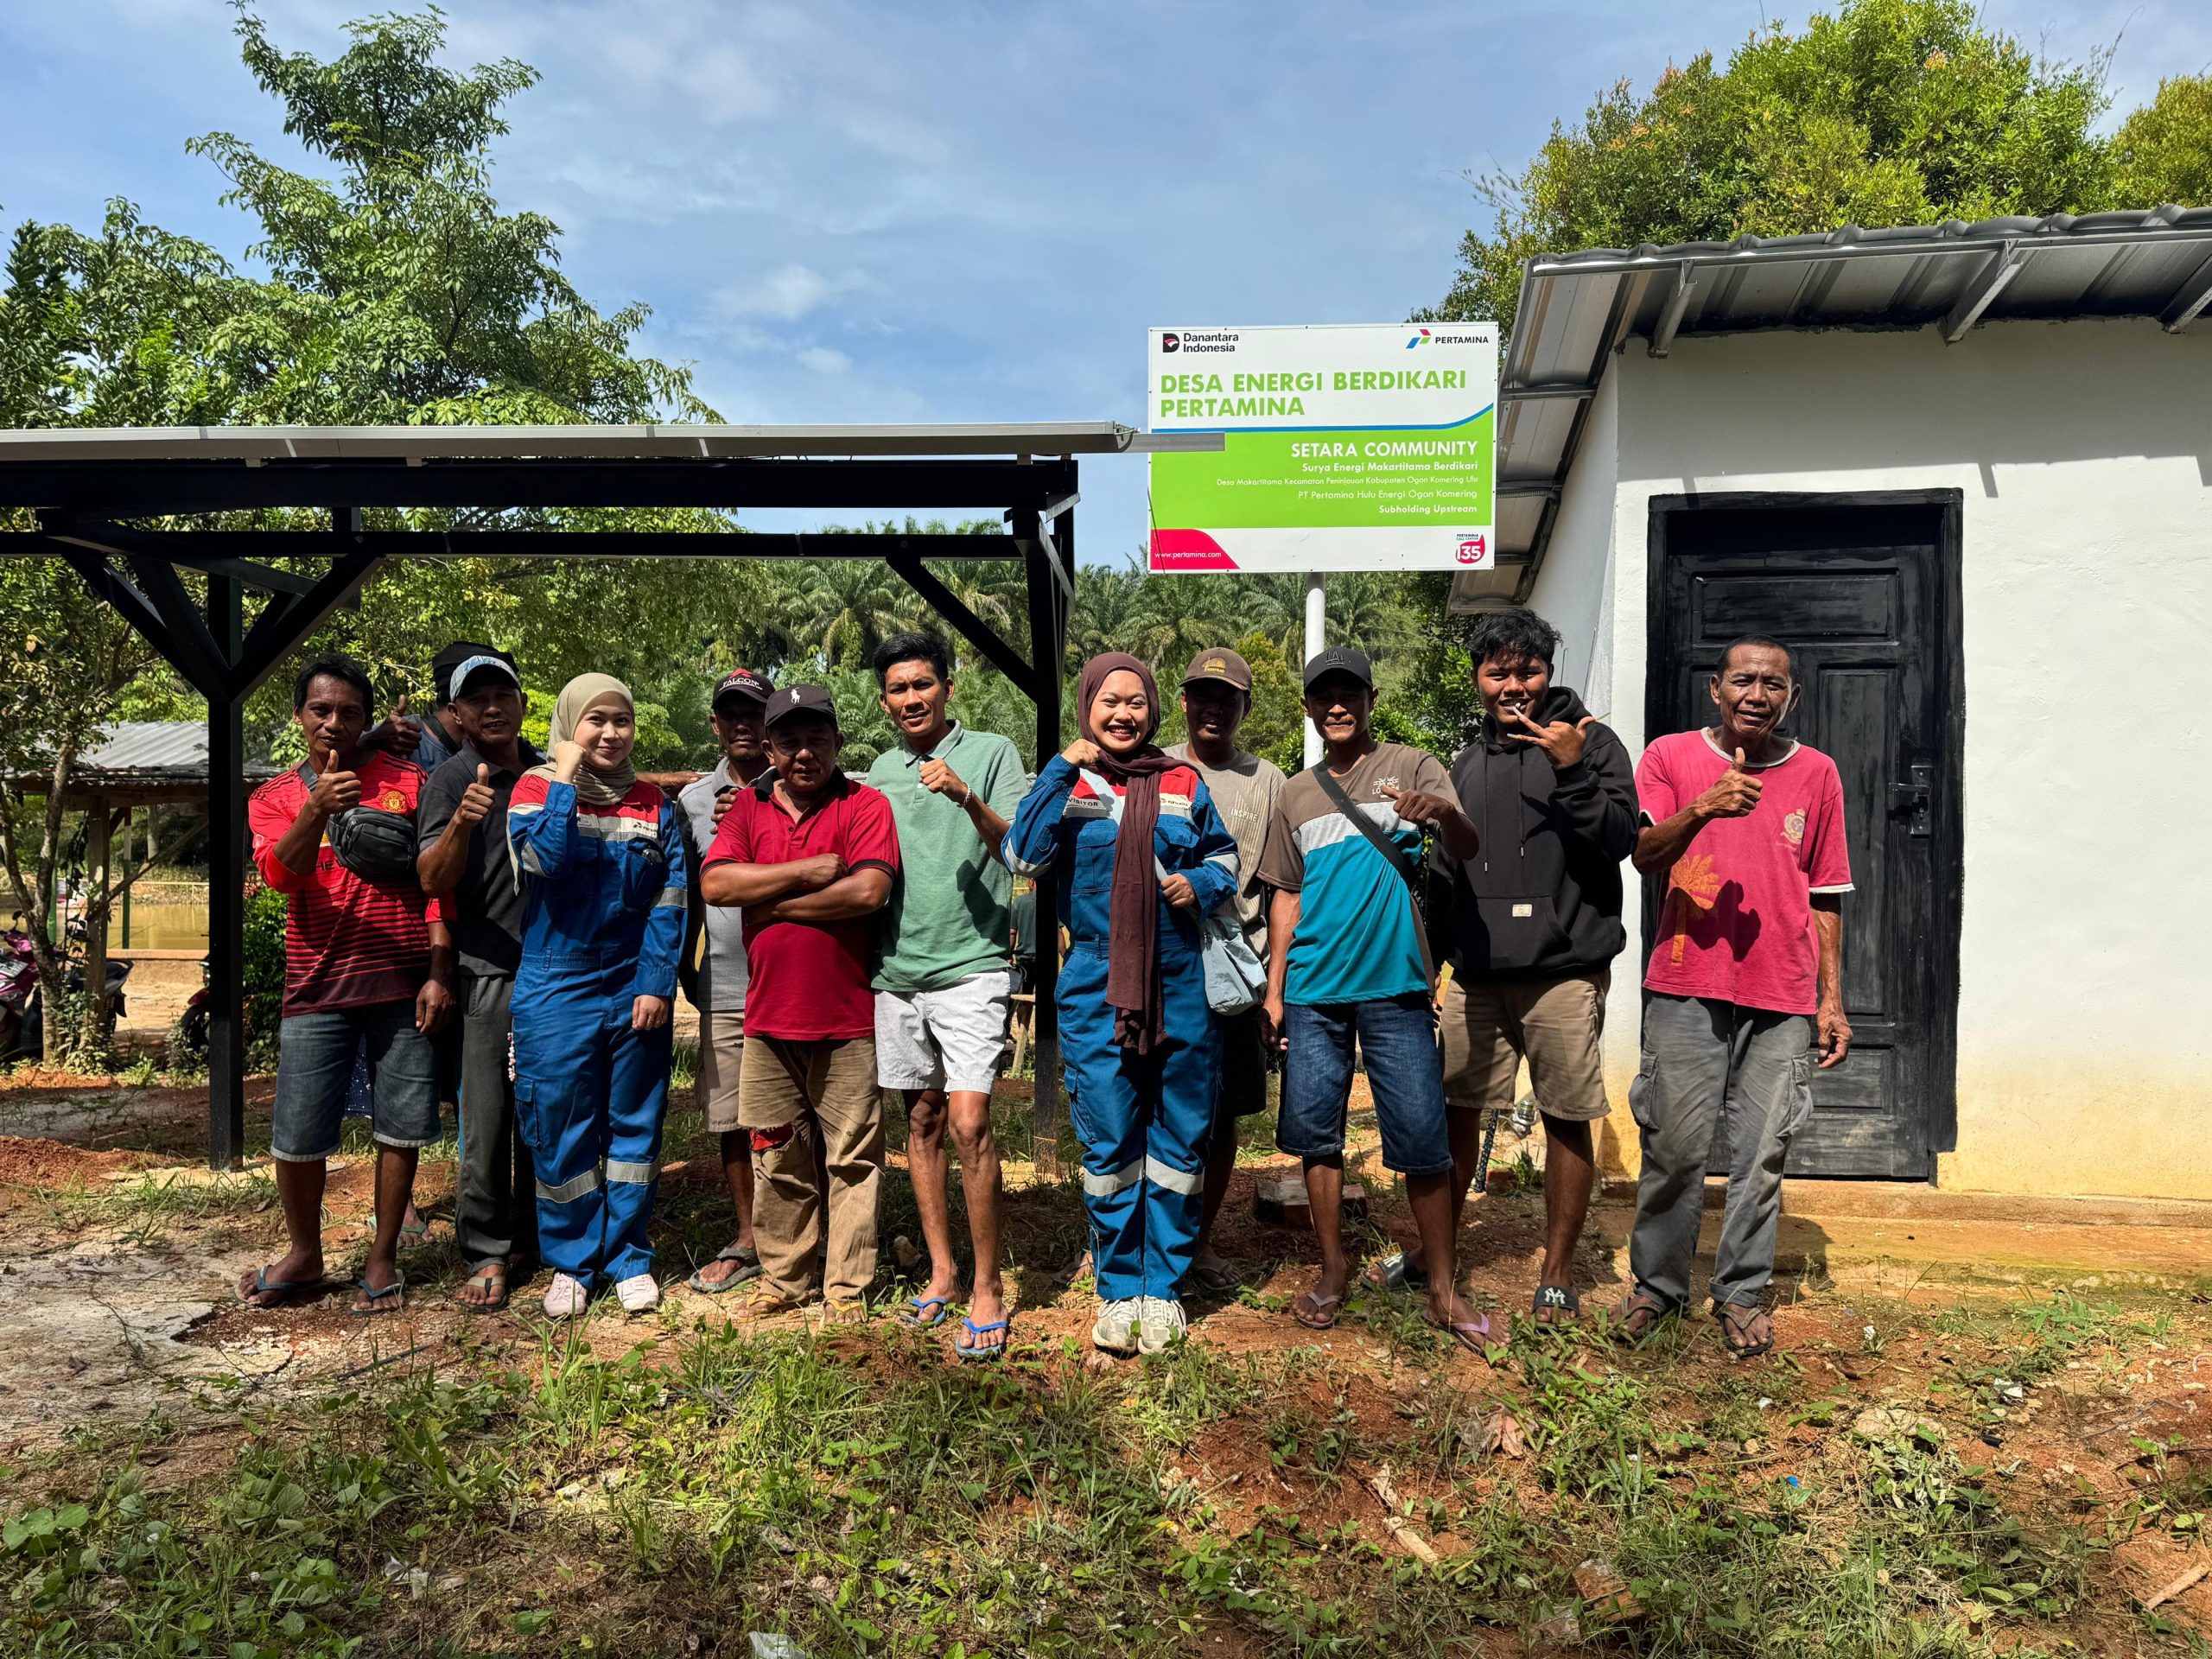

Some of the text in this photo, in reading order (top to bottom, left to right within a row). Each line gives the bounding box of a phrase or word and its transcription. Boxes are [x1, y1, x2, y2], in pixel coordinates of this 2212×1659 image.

[1183, 333, 1239, 342] Danantara
[1183, 343, 1236, 353] Indonesia
[1160, 370, 1466, 393] DESA ENERGI BERDIKARI
[1160, 397, 1305, 417] PERTAMINA
[1291, 441, 1478, 458] SETARA COMMUNITY
[1302, 461, 1478, 474] Surya Energi Makartitama Berdikari
[1326, 477, 1363, 486] Peninjauan
[1365, 476, 1405, 486] Kabupaten
[1407, 476, 1427, 485] Ogan
[1430, 475, 1464, 485] Komering
[1298, 489, 1478, 499] PT Pertamina Hulu Energi Ogan Komering
[1379, 505, 1478, 515] Subholding Upstream
[1154, 550, 1222, 560] www.pertamina.com
[1457, 545, 1481, 560] 135
[1068, 798, 1099, 807] VISITOR
[1230, 808, 1258, 822] INSPIRE
